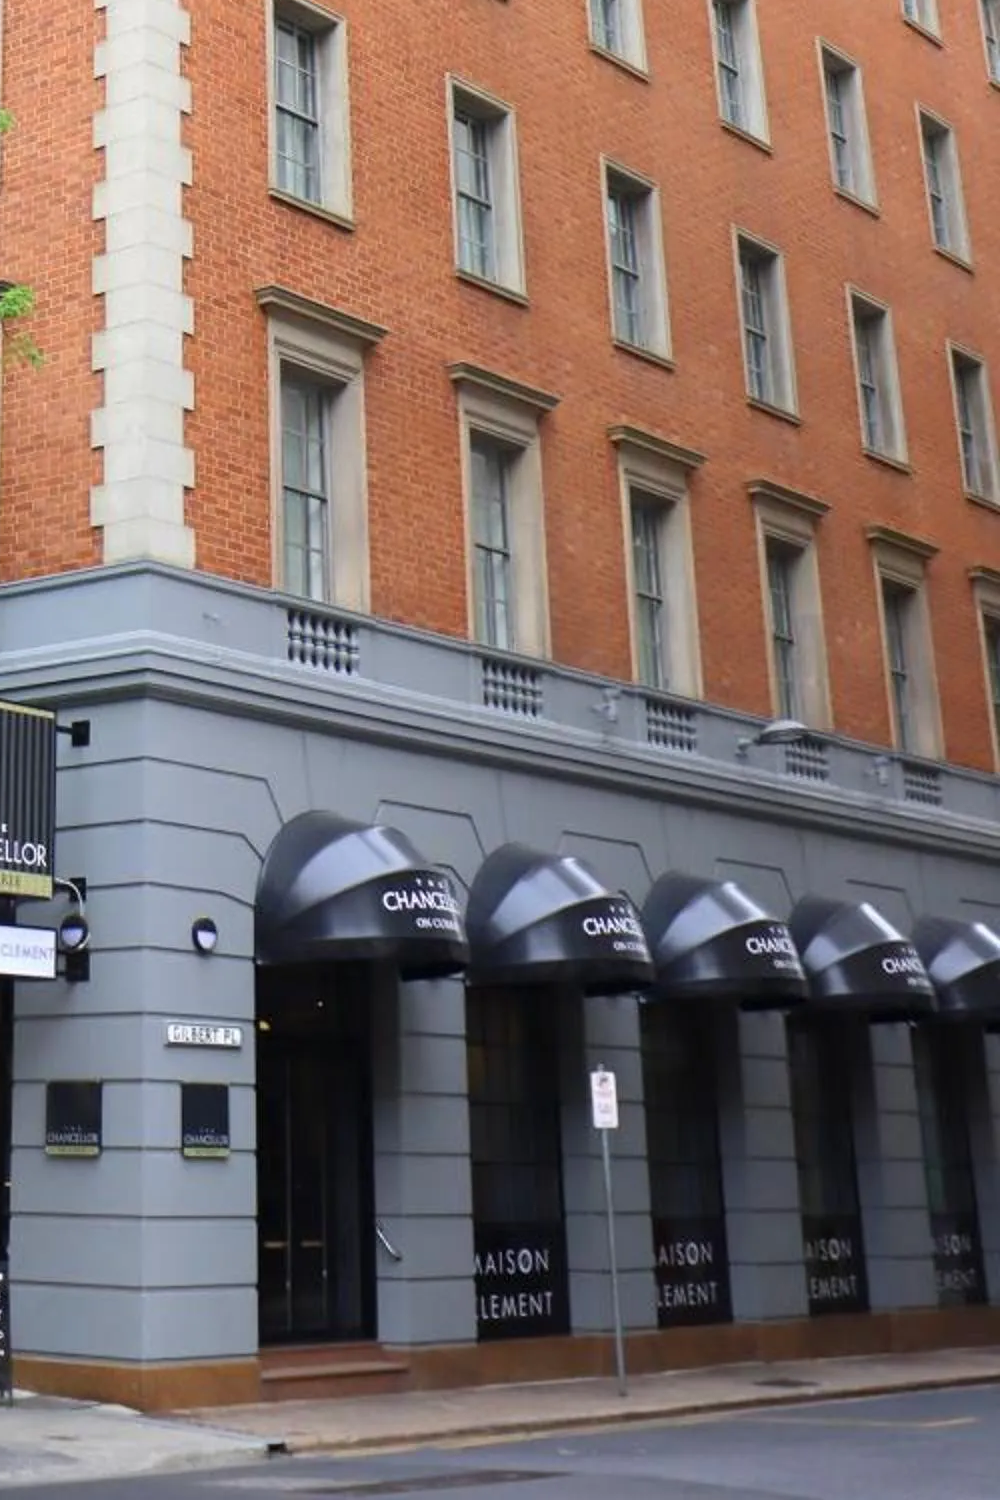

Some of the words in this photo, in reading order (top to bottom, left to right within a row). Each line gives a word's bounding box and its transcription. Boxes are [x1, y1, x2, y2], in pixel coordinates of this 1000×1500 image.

[0, 943, 56, 961] CLEMENT
[173, 1026, 218, 1043] GILBERT
[223, 1029, 238, 1045] PL
[657, 1242, 713, 1266] AISON
[477, 1292, 553, 1319] LEMENT
[657, 1282, 717, 1307] LEMENT
